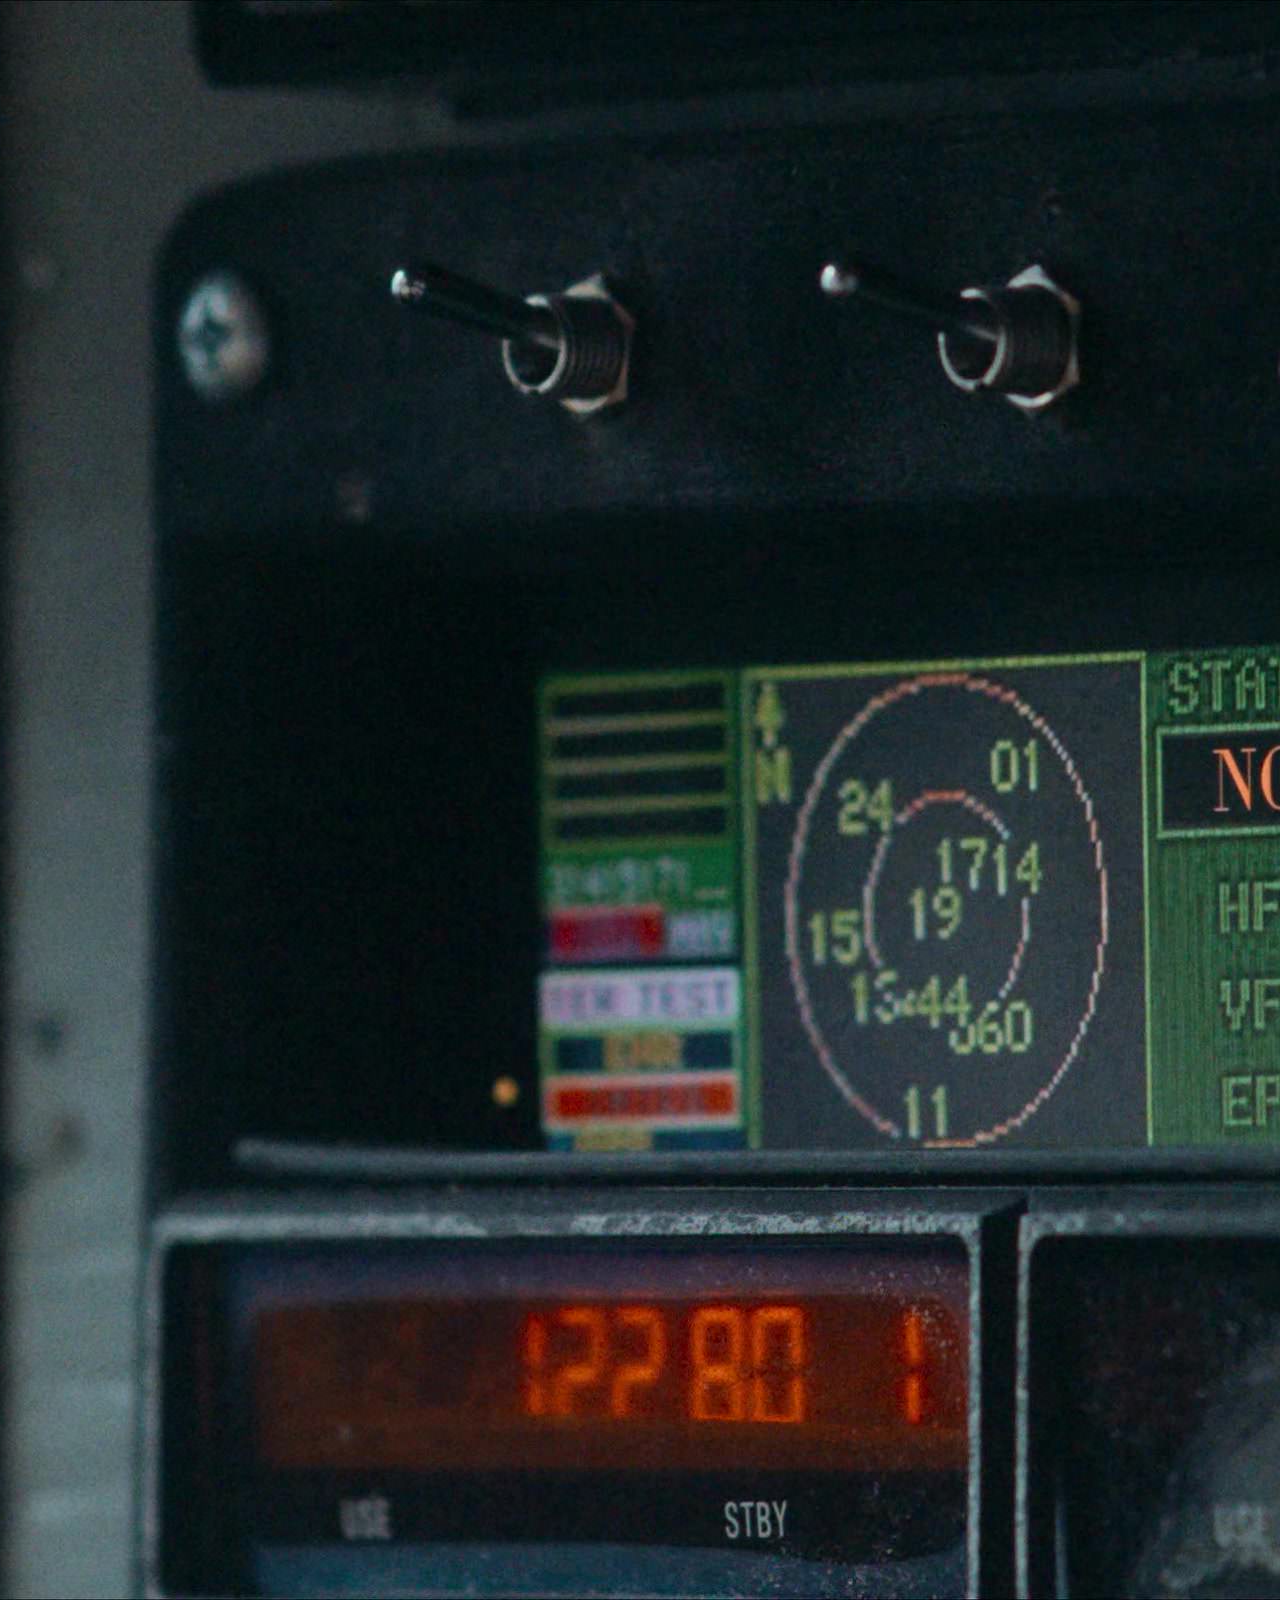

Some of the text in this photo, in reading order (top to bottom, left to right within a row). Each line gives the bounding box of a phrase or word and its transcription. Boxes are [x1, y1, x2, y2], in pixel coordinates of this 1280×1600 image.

[990, 739, 1038, 794] 01
[837, 777, 892, 836] 24
[809, 908, 861, 966] 15
[910, 886, 962, 940] 19
[904, 1085, 947, 1140] 11
[724, 1499, 789, 1540] STBY
